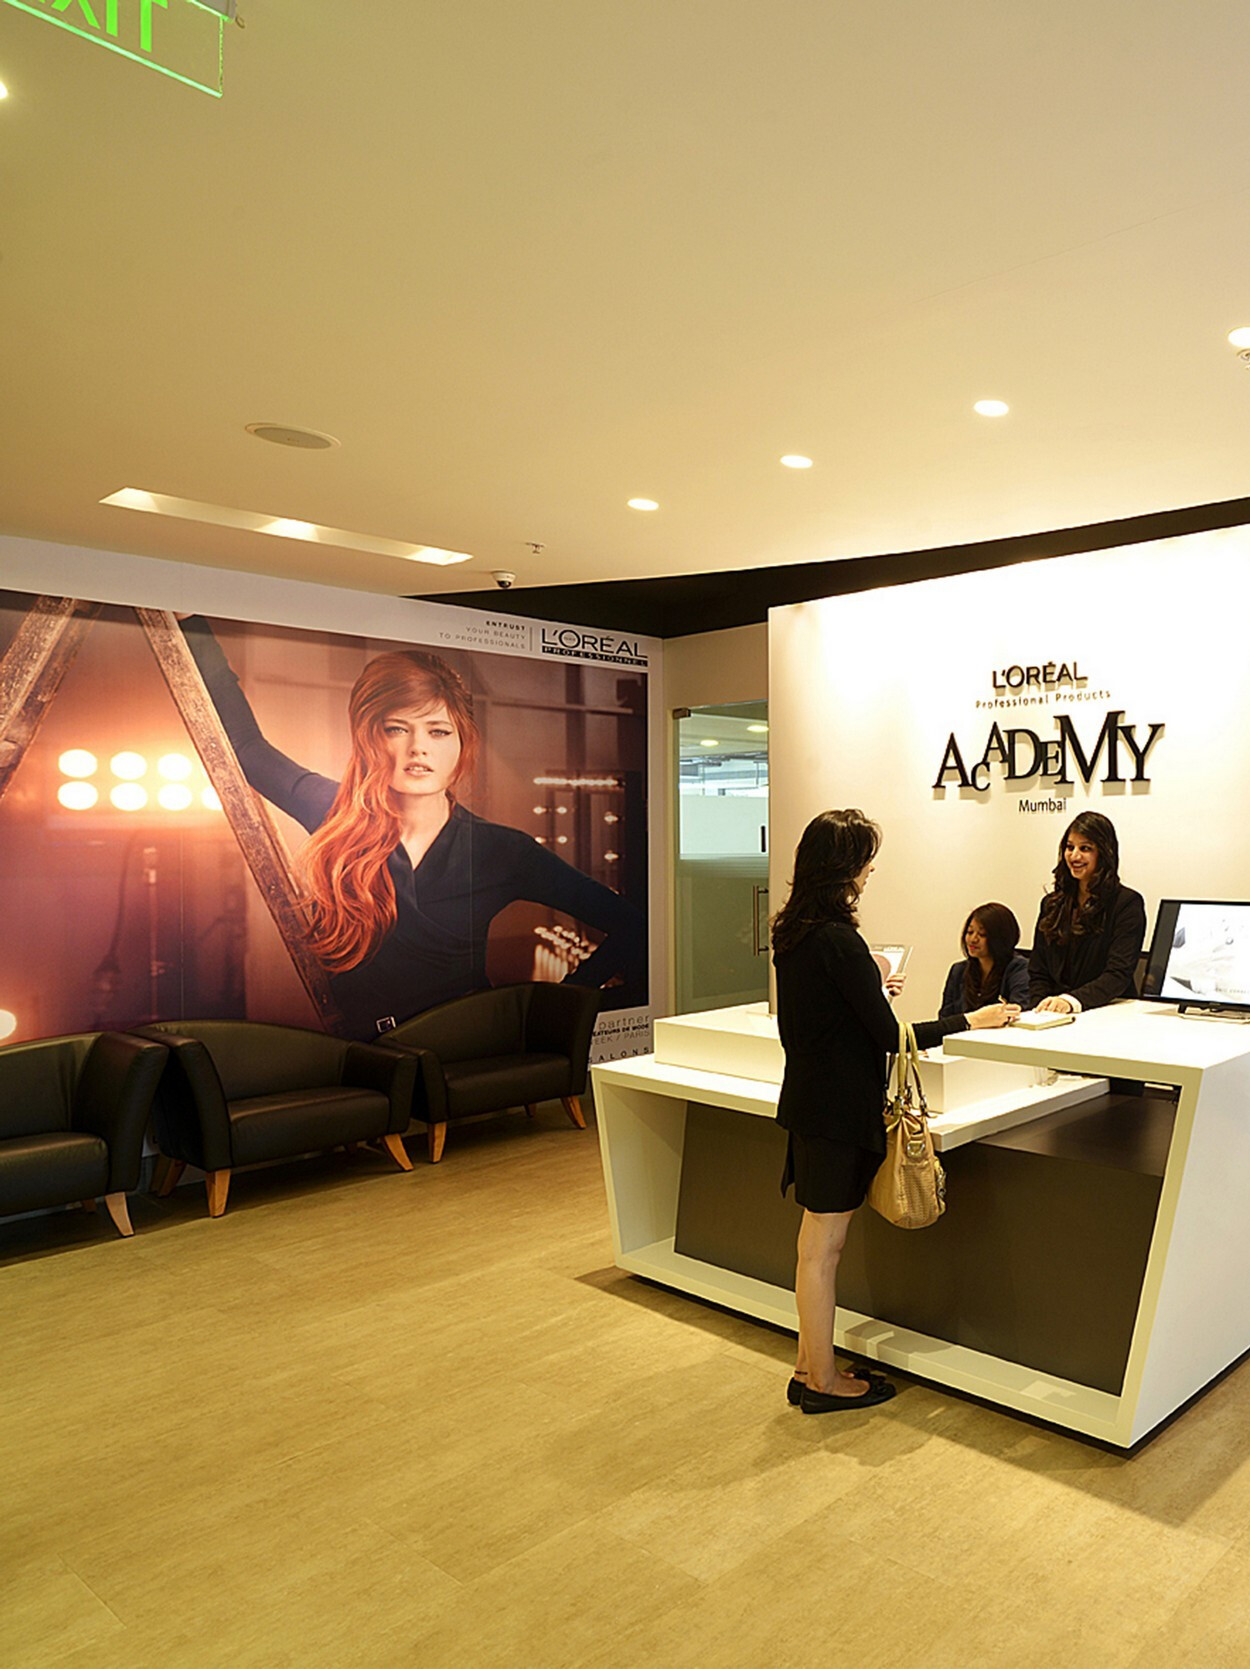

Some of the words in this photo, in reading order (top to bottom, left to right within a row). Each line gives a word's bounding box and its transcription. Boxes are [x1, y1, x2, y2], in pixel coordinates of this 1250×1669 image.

[466, 626, 490, 635] YOUR
[494, 630, 525, 640] BEAUTY
[485, 620, 526, 631] ENTRUST
[439, 632, 451, 640] TO
[455, 634, 526, 649] PROFESSIONALS
[541, 628, 648, 659] L'ORÉAL
[544, 646, 646, 667] PROFESSIONNEL
[992, 661, 1088, 689] L'ORÉAL
[976, 694, 1049, 709] Professional
[1055, 689, 1112, 702] Products
[1018, 797, 1067, 813] Mumbai
